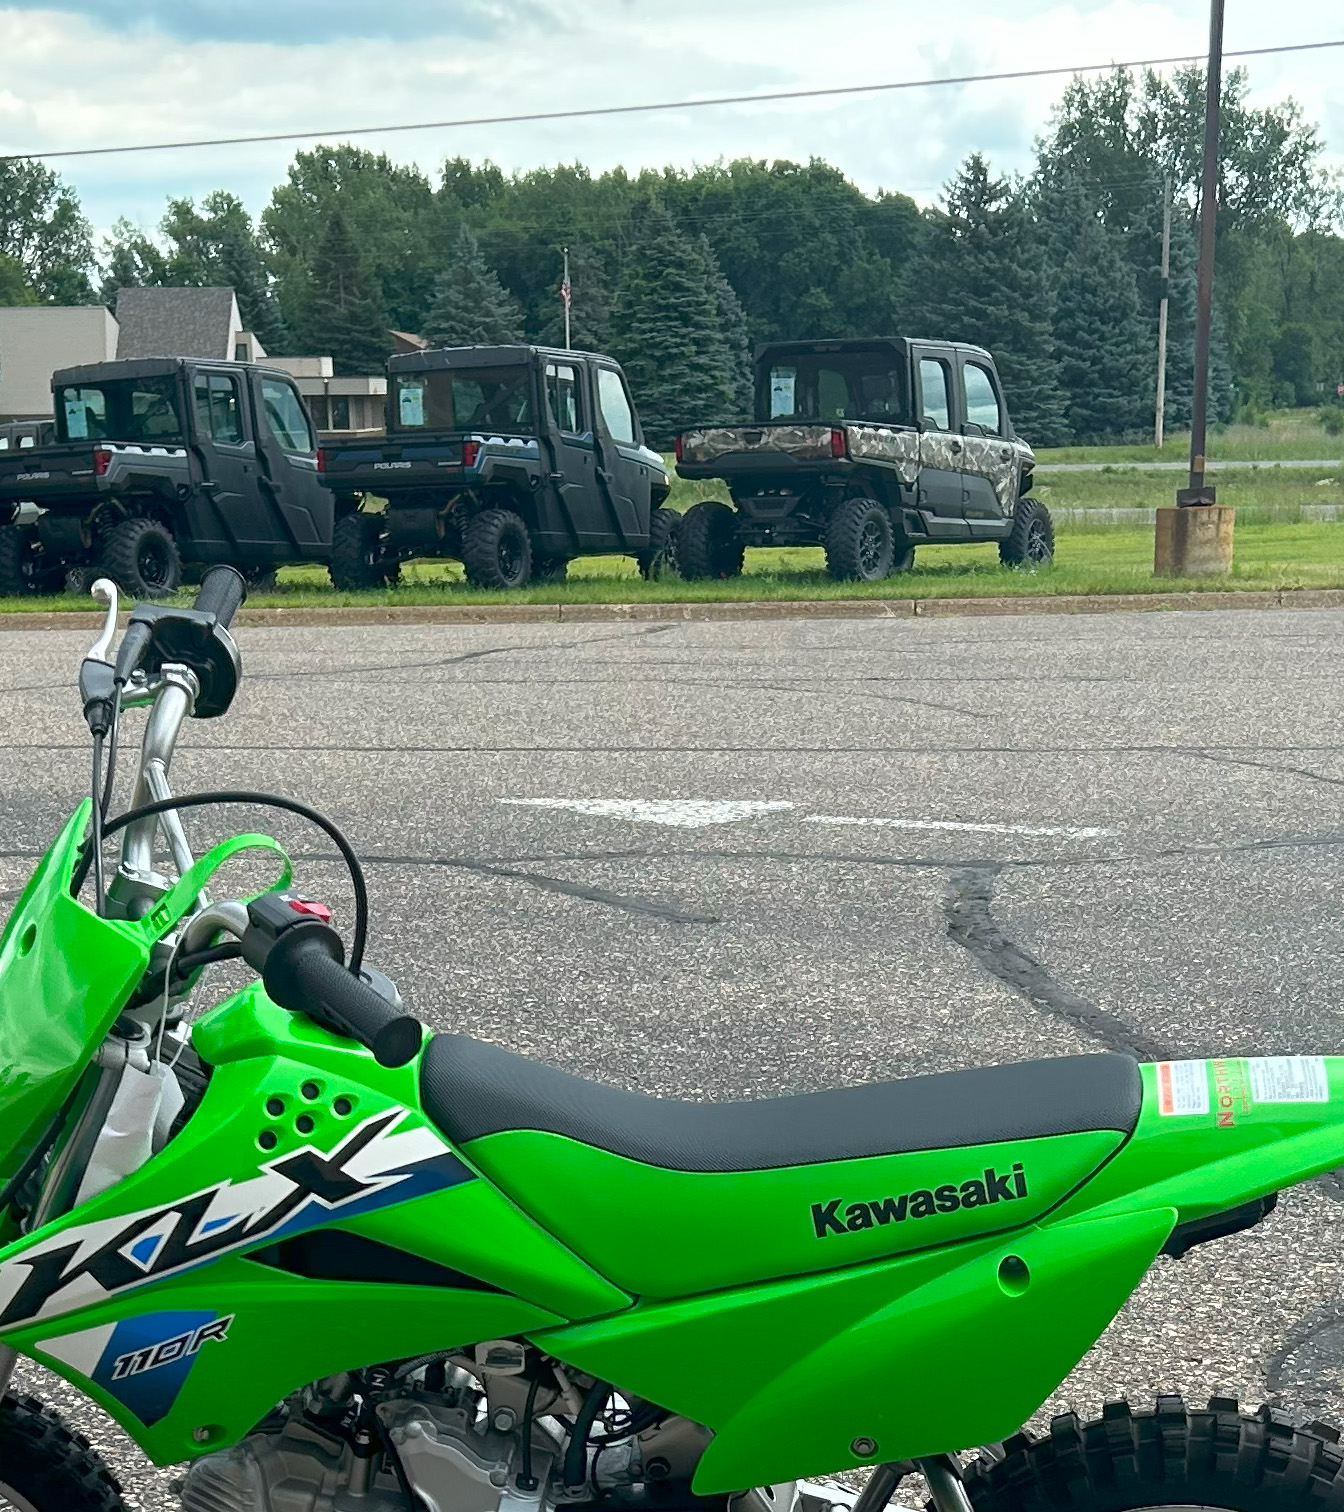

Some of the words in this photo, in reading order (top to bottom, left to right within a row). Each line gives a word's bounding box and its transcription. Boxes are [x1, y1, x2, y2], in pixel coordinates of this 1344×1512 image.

[17, 472, 50, 480] POLARIS
[374, 461, 412, 470] POLARIS
[810, 1162, 1028, 1239] Kawasaki
[111, 1313, 235, 1380] 110R
